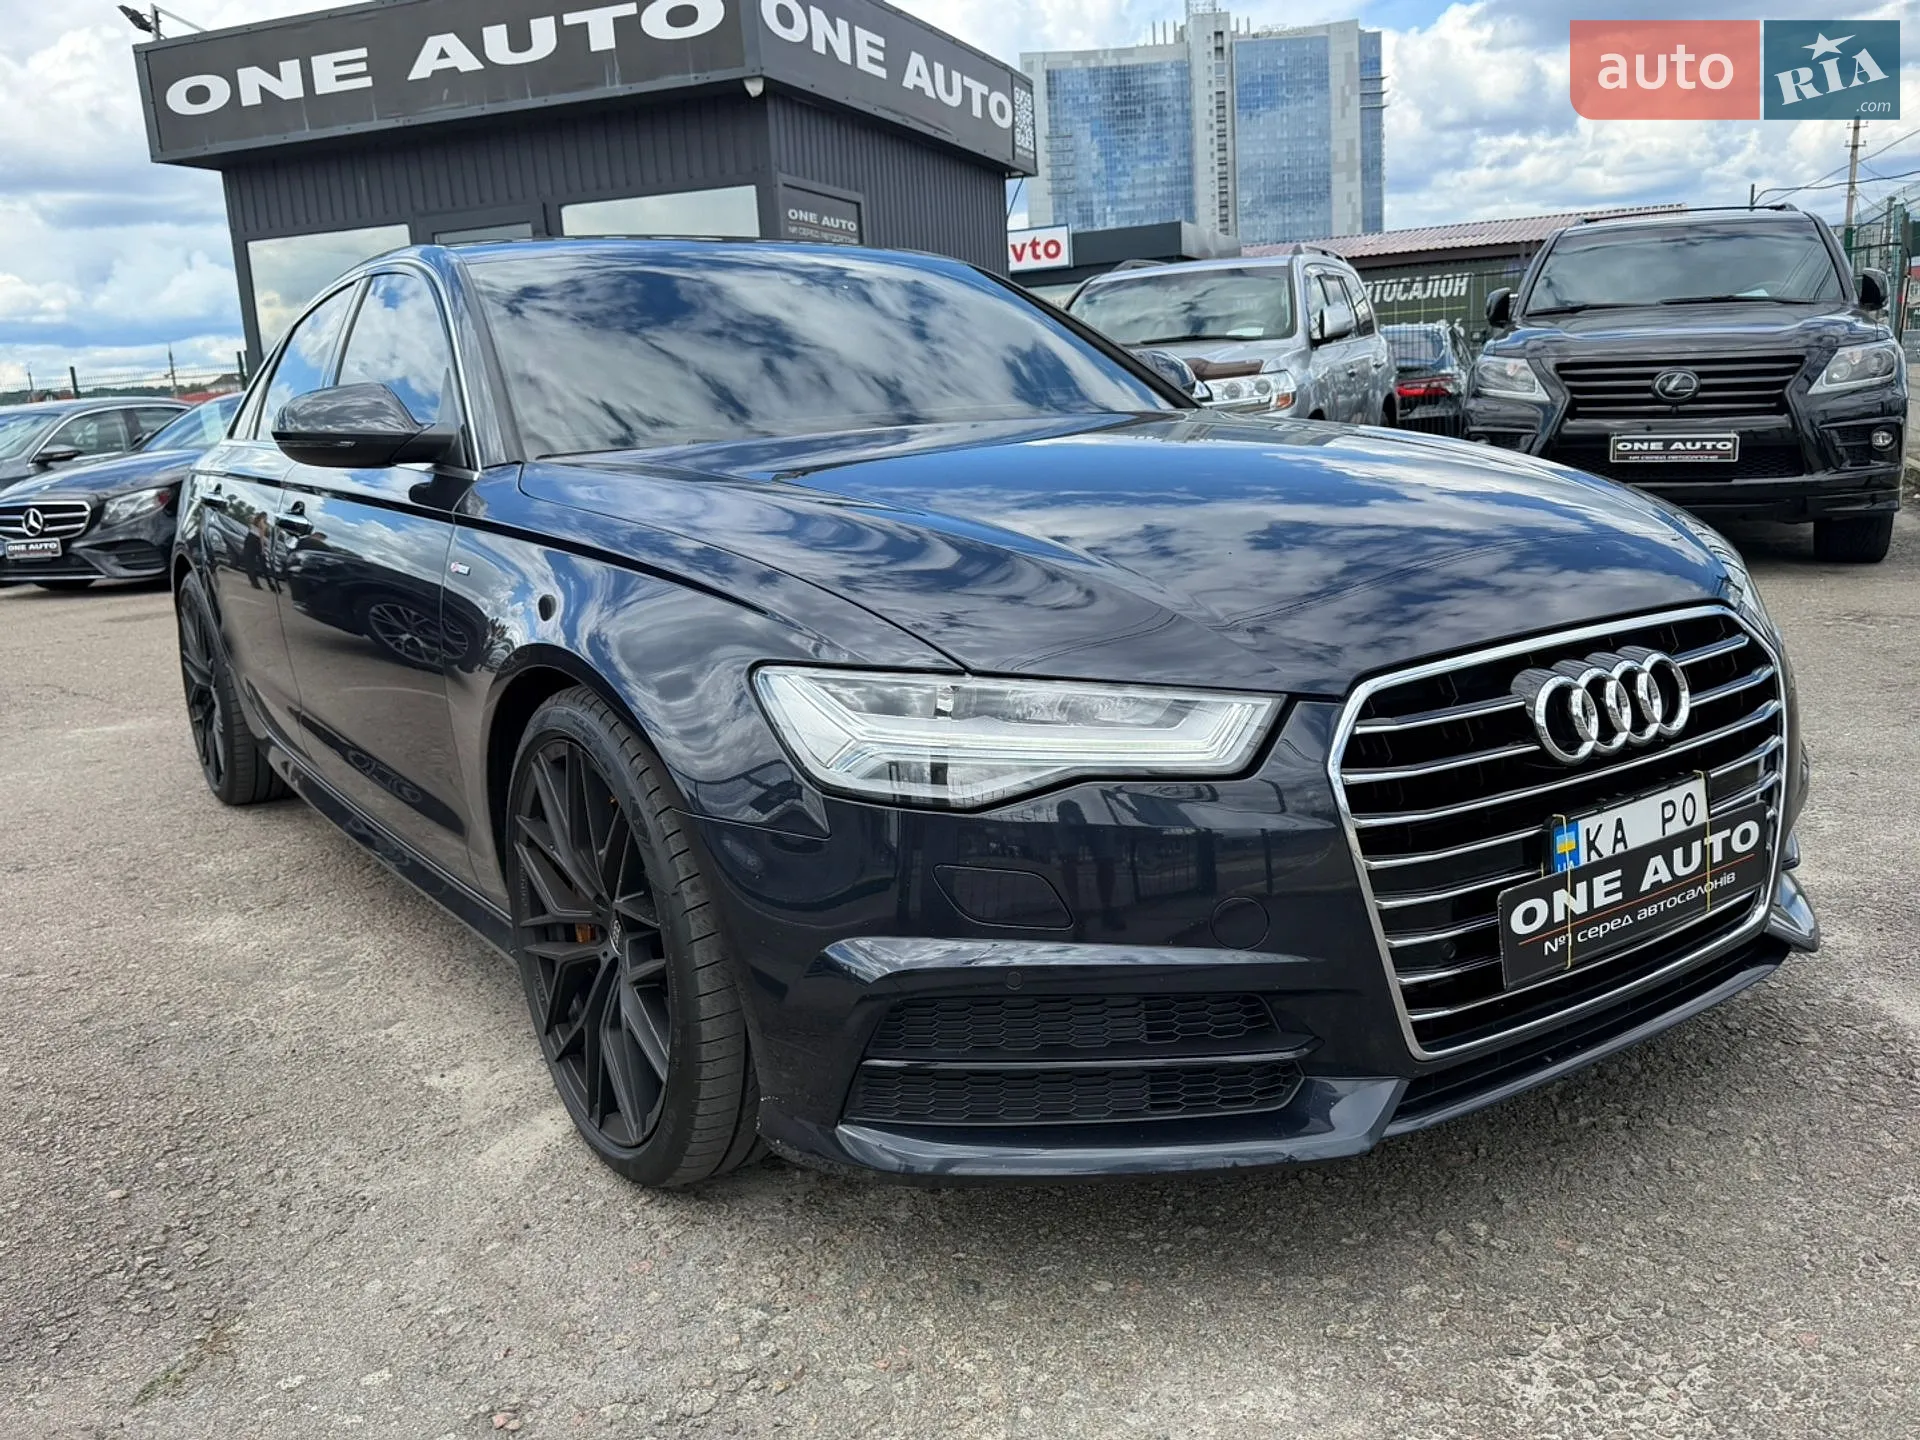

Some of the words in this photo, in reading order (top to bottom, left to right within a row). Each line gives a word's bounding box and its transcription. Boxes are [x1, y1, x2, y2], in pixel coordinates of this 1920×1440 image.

[165, 47, 373, 116] ONE
[407, 0, 725, 81] AUTO
[760, 0, 887, 80] ONE
[902, 50, 1013, 129] AUTO
[788, 208, 818, 224] ONE
[822, 215, 857, 232] AUTO
[1010, 236, 1062, 262] vto
[1363, 271, 1473, 304] ТОСАЛОН
[1616, 441, 1664, 451] ONE
[1669, 441, 1733, 450] AUTO
[29, 542, 57, 550] AUTO
[1585, 816, 1628, 862] KA
[1661, 791, 1697, 837] PO
[1509, 869, 1623, 935] ONE
[1640, 820, 1760, 892] AUTO
[1577, 914, 1634, 942] серед
[1637, 871, 1737, 921] автосалонів
